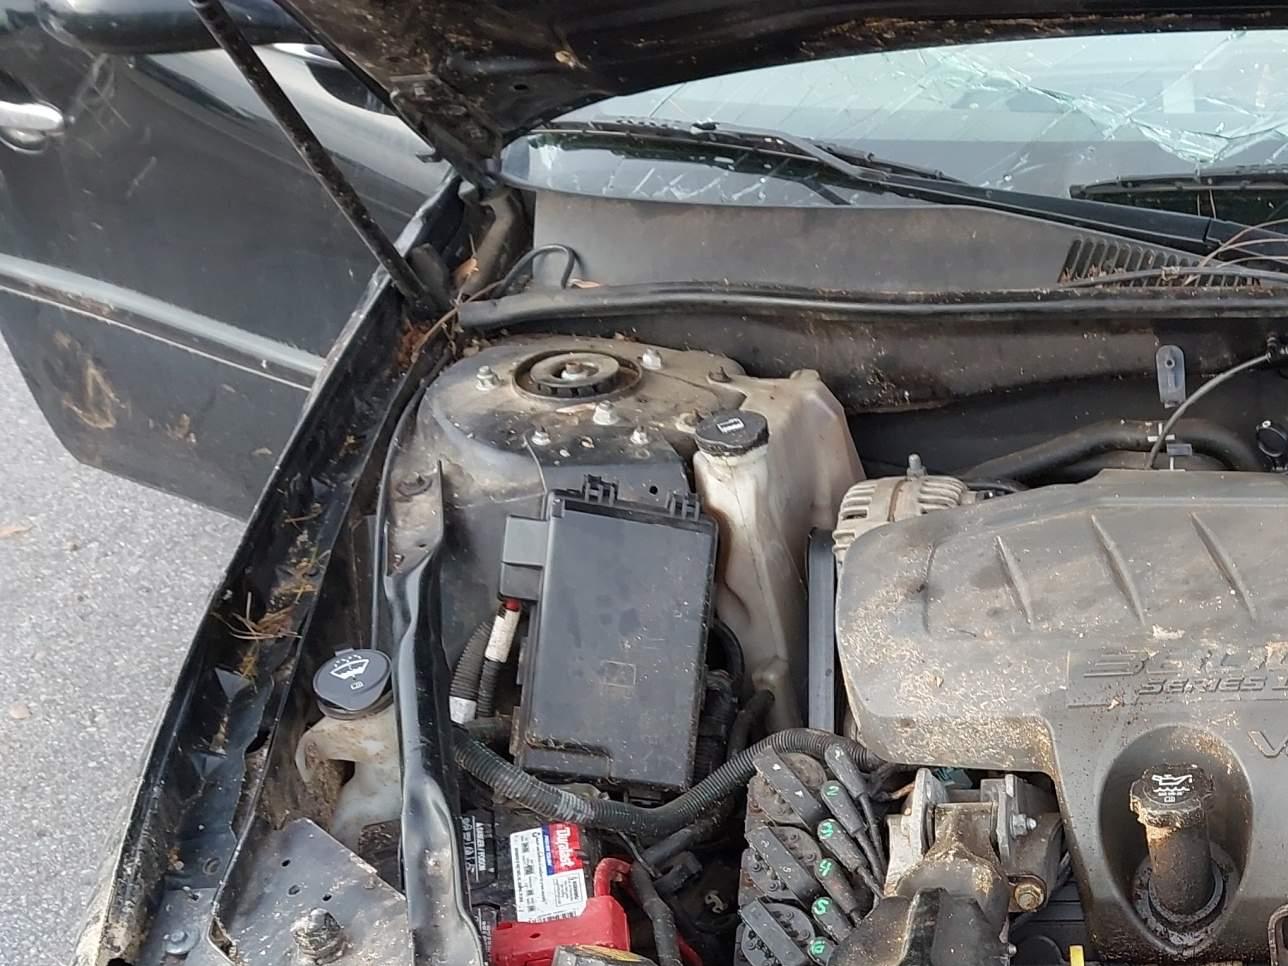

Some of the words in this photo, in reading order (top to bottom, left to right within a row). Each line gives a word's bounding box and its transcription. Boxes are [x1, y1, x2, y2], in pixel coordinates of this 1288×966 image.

[1137, 675, 1267, 695] SERIES
[826, 785, 840, 796] 2
[818, 821, 834, 838] 3
[555, 826, 576, 868] Duralast
[818, 862, 833, 876] 4
